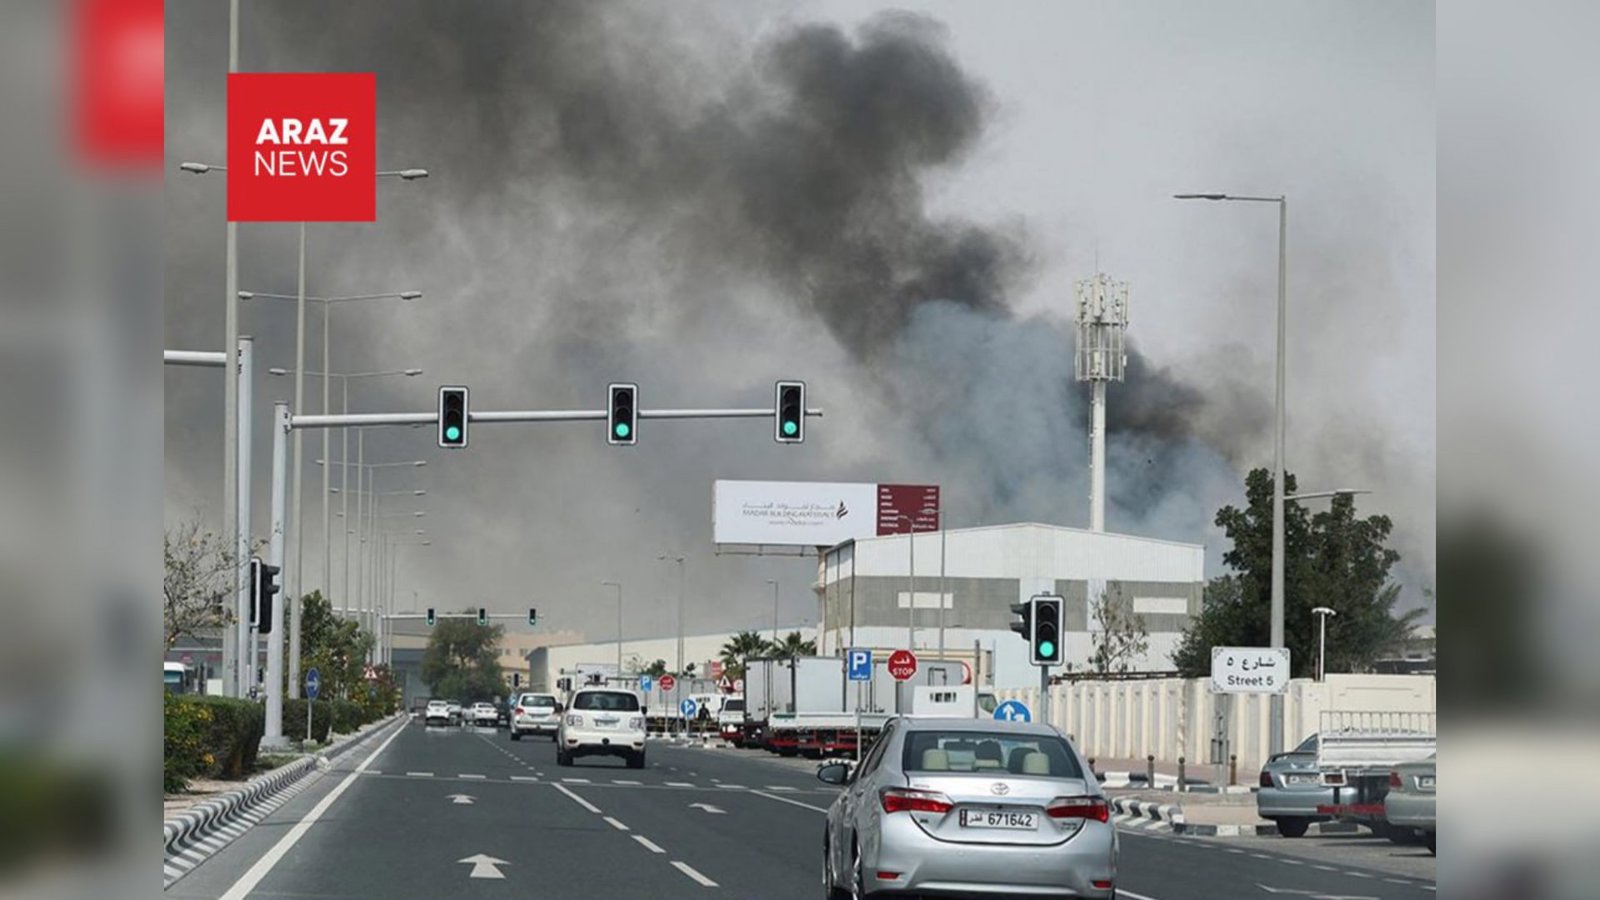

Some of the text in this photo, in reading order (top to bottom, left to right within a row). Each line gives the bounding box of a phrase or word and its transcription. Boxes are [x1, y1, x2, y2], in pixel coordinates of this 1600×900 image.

[853, 653, 867, 671] P
[894, 654, 911, 664] قف
[1227, 656, 1275, 671] شارع ٥
[892, 667, 913, 676] STOP
[642, 676, 650, 686] P
[1227, 675, 1274, 686] Street 5
[969, 813, 983, 823] قطر
[988, 813, 1032, 827] 671642
